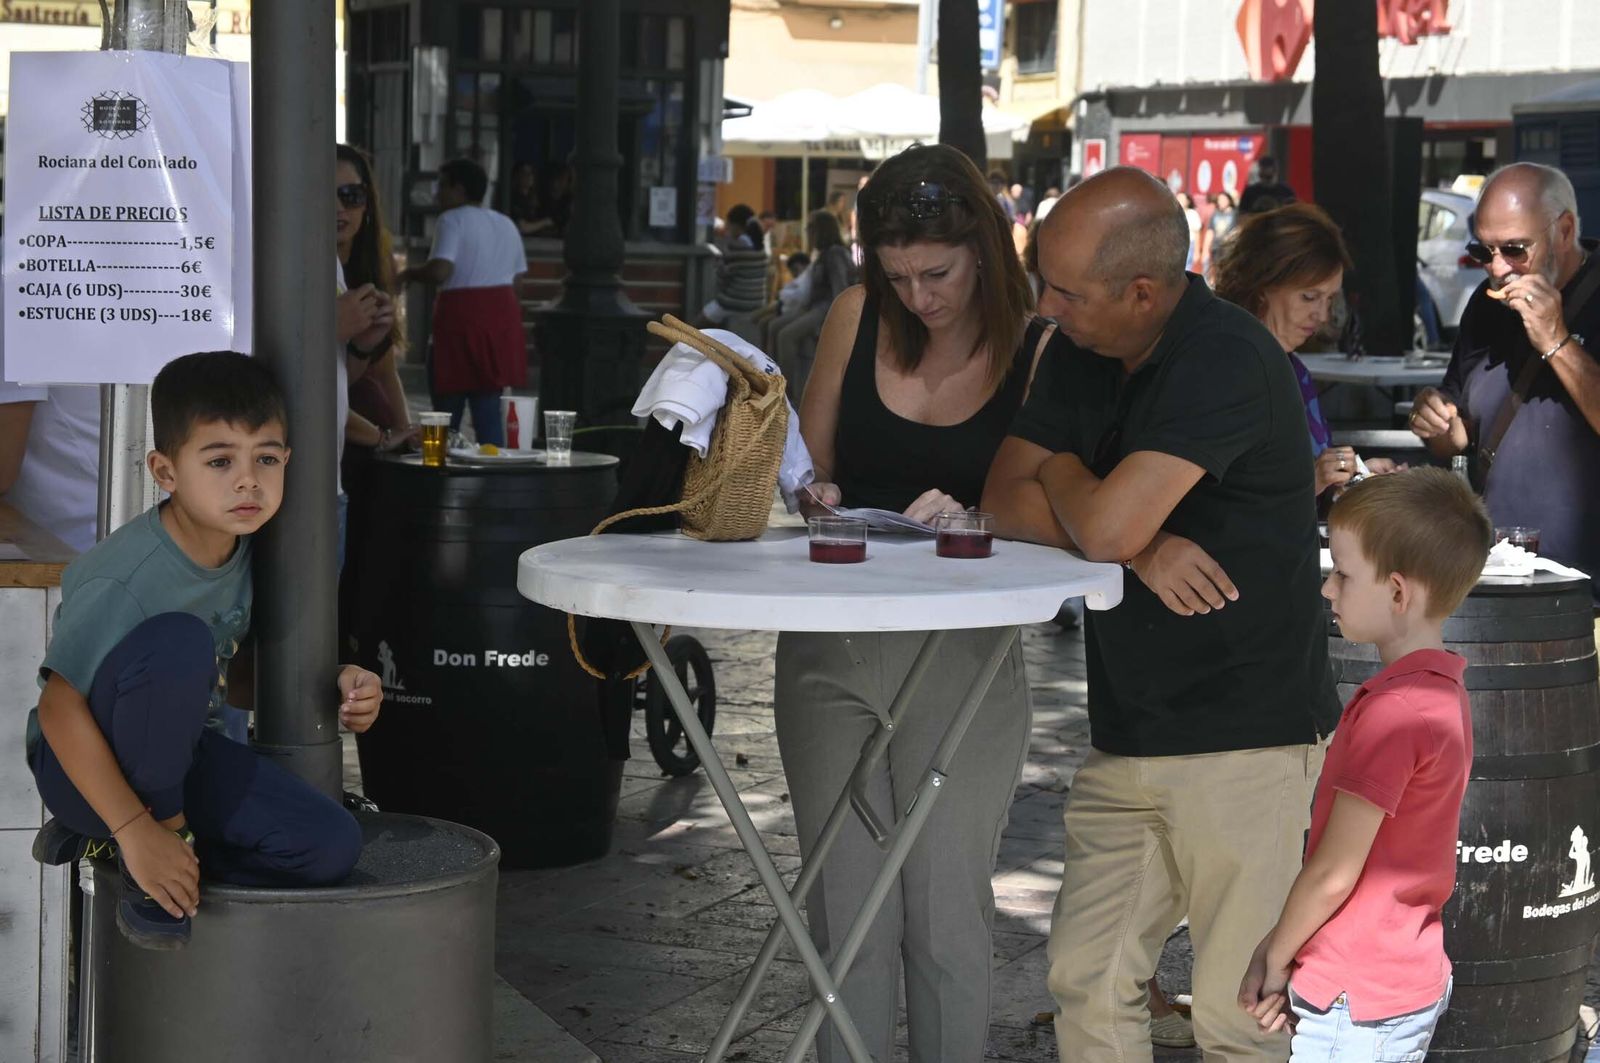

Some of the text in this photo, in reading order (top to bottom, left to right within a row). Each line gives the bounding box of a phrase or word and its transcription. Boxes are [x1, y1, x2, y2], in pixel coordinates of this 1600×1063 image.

[38, 155, 197, 170] Rociana del Condado
[39, 205, 189, 222] LISTA DE PRECIOS
[26, 283, 62, 298] CAJA
[66, 283, 82, 299] (6
[26, 307, 96, 321] ESTUCHE
[100, 308, 115, 324] (3
[433, 648, 549, 667] Don Frede
[396, 694, 433, 705] socorro
[1522, 903, 1571, 919] Bodegas
[1572, 895, 1586, 912] del
